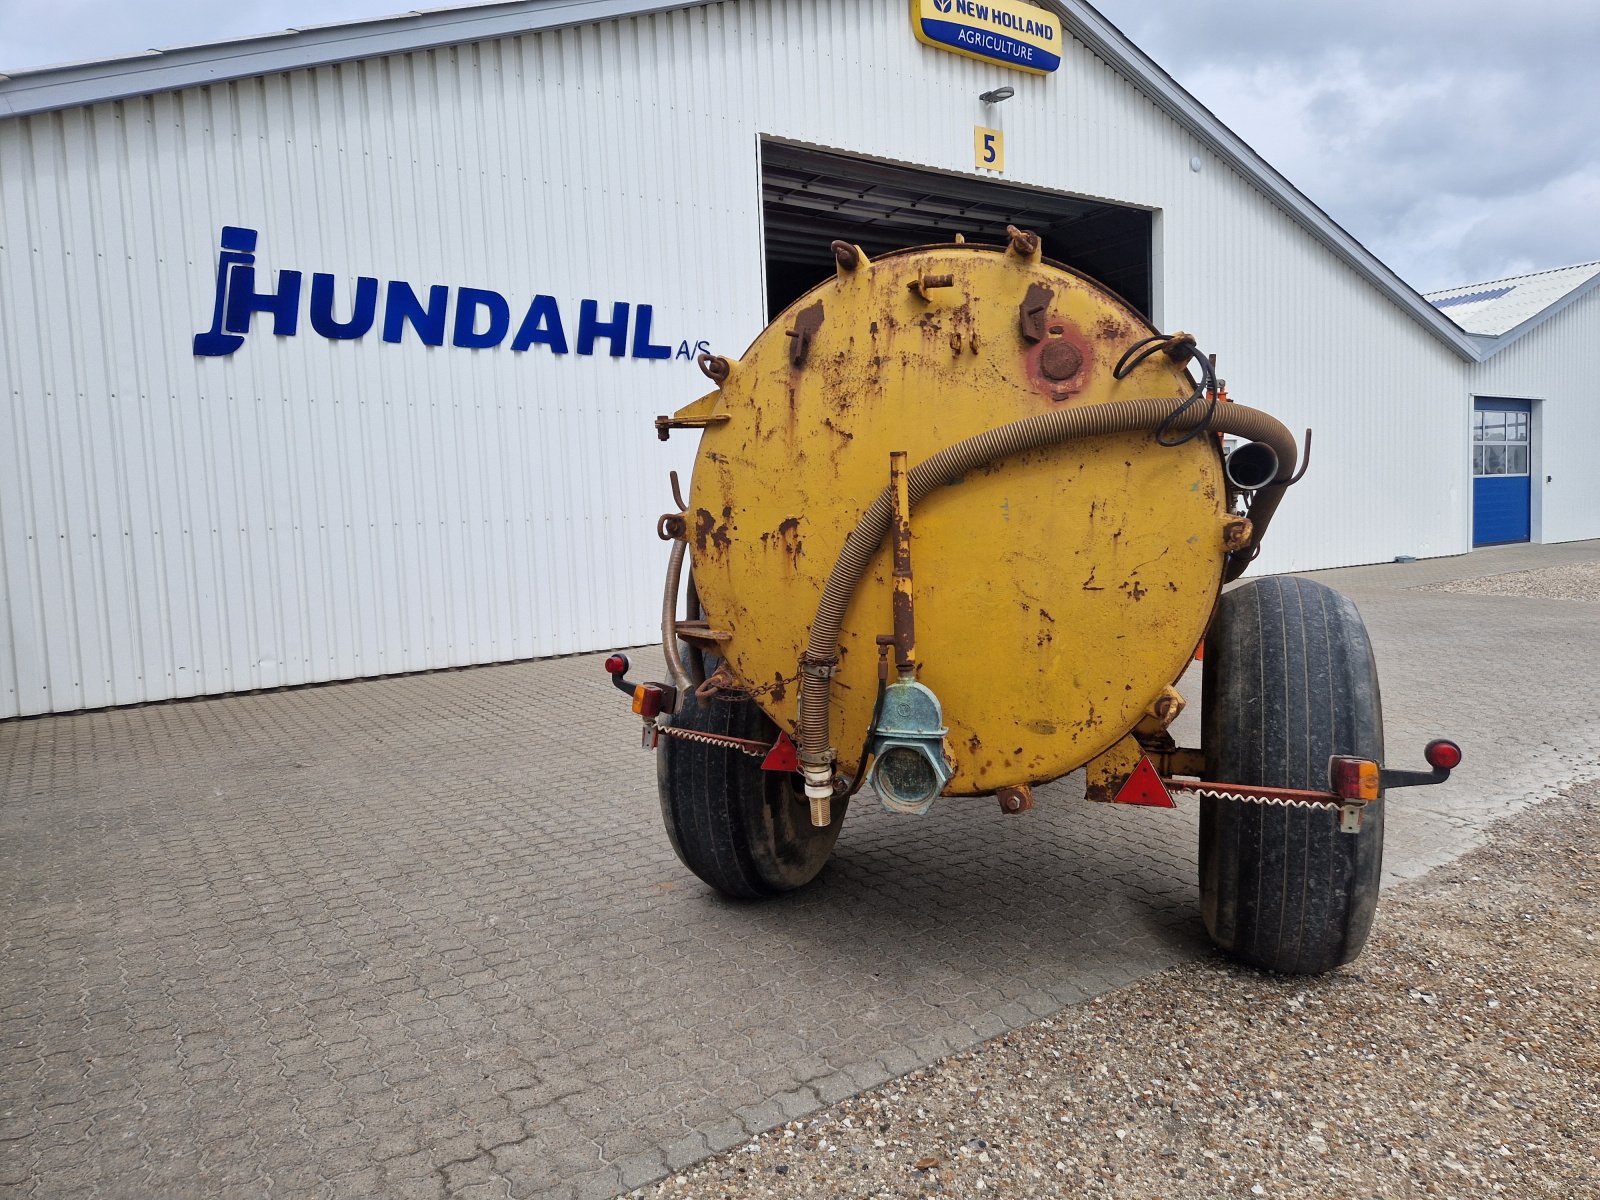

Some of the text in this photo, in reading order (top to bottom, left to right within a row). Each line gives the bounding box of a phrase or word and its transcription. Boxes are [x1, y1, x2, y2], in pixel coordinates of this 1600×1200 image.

[956, 0, 1053, 41] NEW HOLLAND
[958, 29, 1033, 61] AGRICULTURE
[983, 134, 996, 163] 5
[676, 340, 711, 361] A/S
